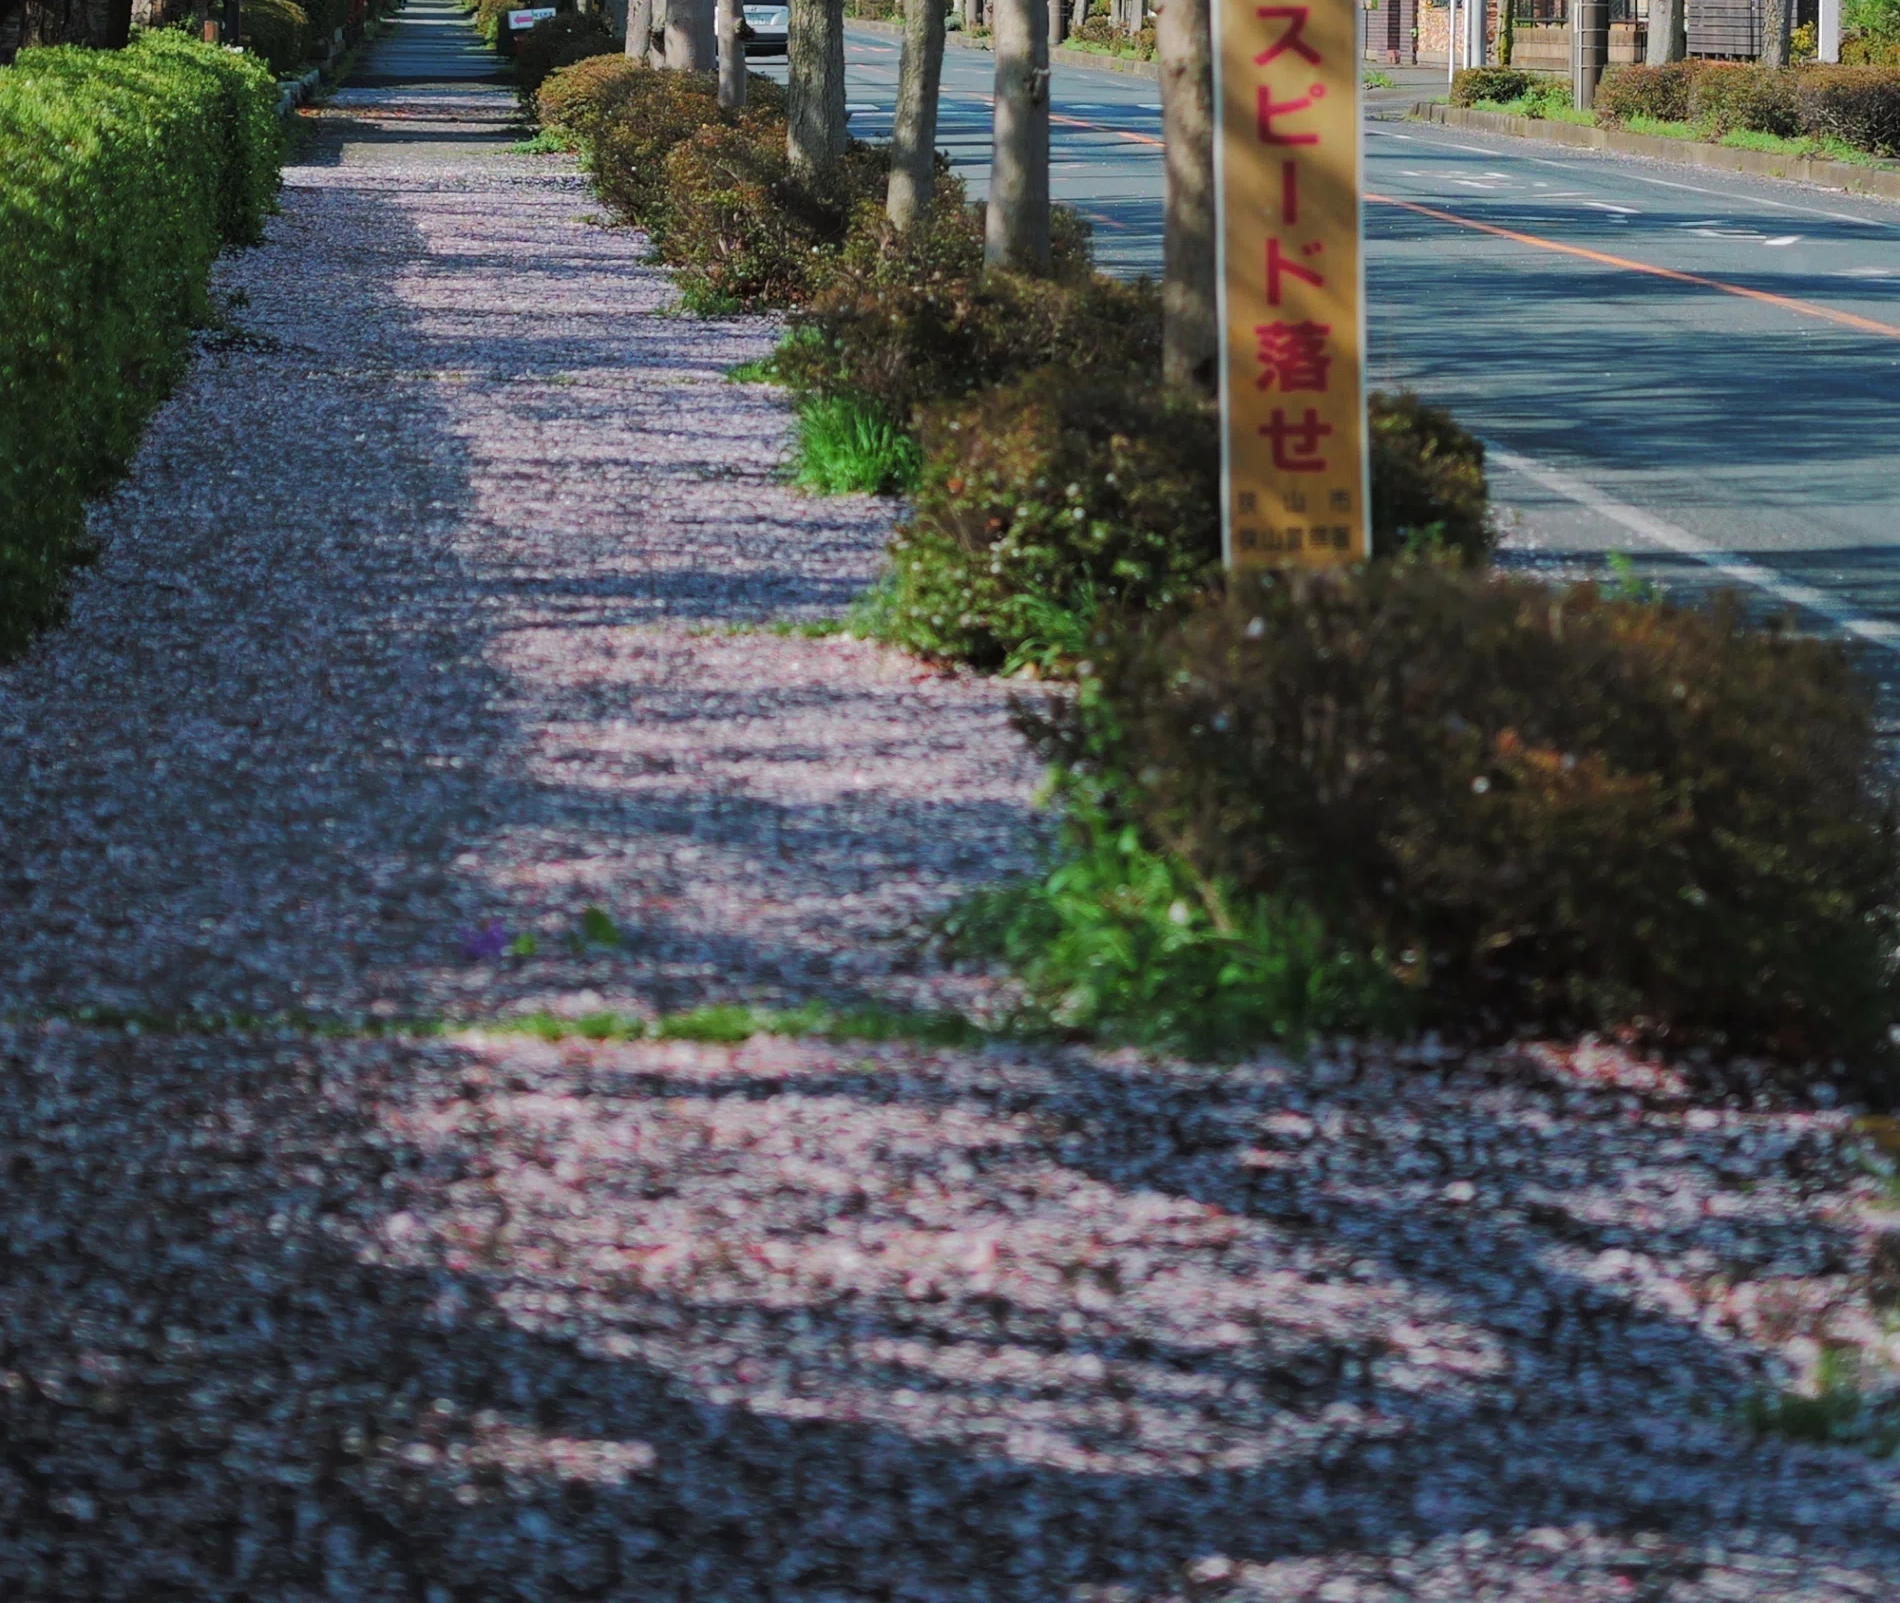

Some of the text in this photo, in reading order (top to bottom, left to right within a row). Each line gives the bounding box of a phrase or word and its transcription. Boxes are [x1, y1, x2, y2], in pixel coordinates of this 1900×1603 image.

[1254, 7, 1332, 472] スピード落せ
